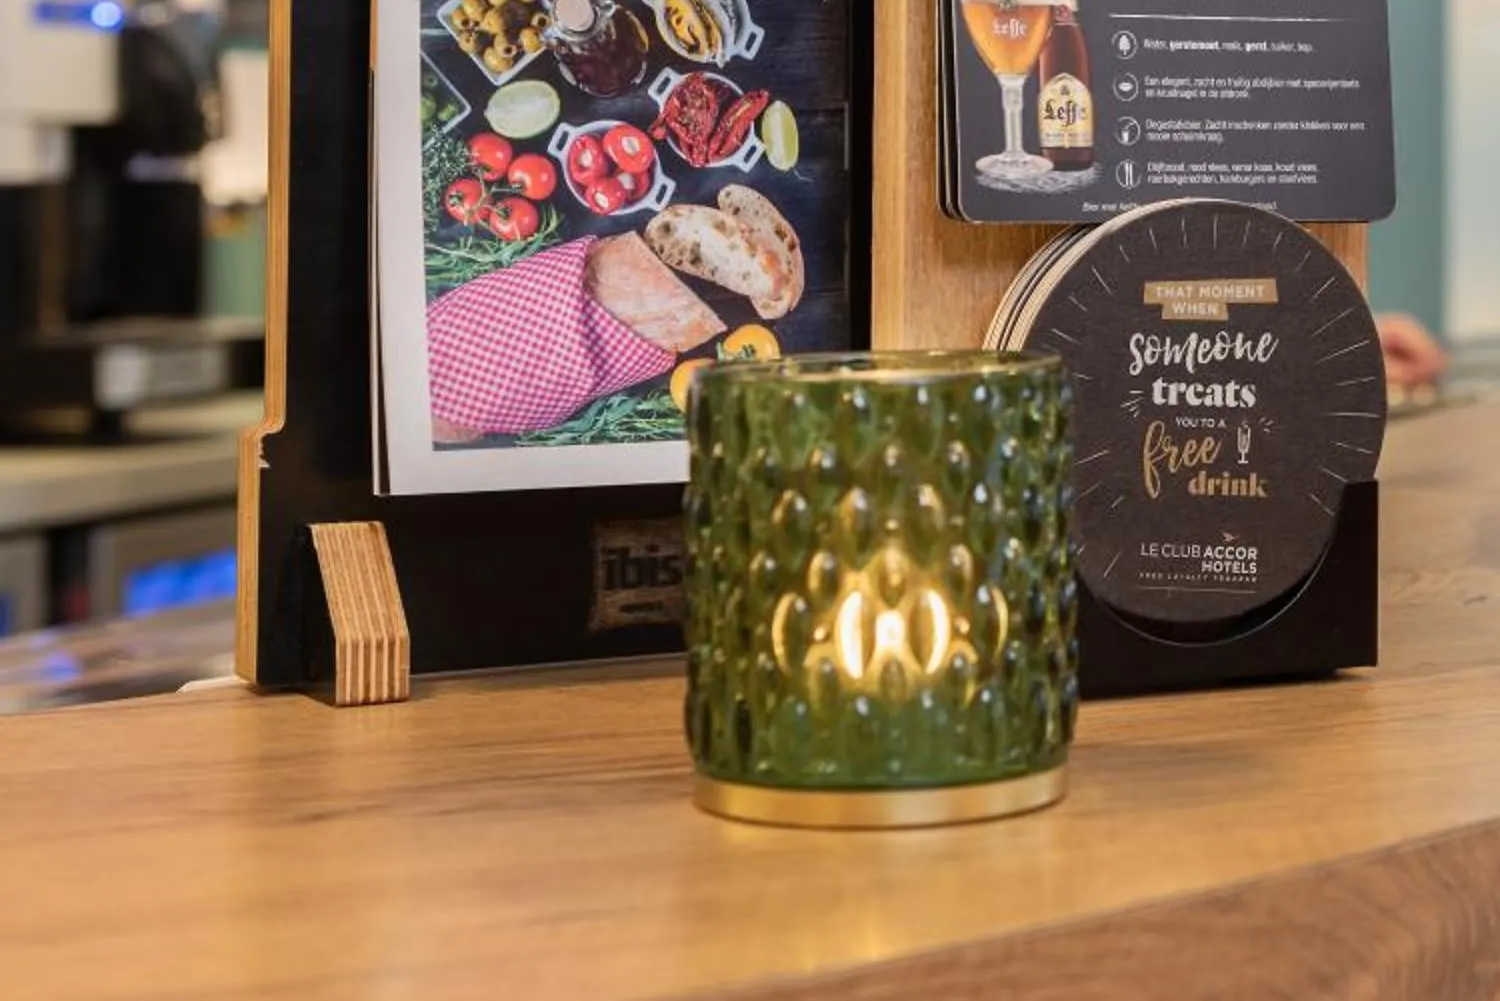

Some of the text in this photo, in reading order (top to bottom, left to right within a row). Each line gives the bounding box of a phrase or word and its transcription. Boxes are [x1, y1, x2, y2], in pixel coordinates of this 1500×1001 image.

[991, 18, 1028, 40] Leffe
[1043, 99, 1088, 128] Leffe
[1155, 285, 1266, 299] THAT MOMENT
[1172, 302, 1219, 316] WHEN
[1151, 376, 1257, 408] treats
[1175, 416, 1227, 429] YOU TO A
[1143, 420, 1223, 499] free
[1187, 470, 1268, 498] drink
[1140, 542, 1258, 561] LE CLUB ACCOR
[601, 546, 683, 591] ibis
[1201, 560, 1258, 575] HOTELS
